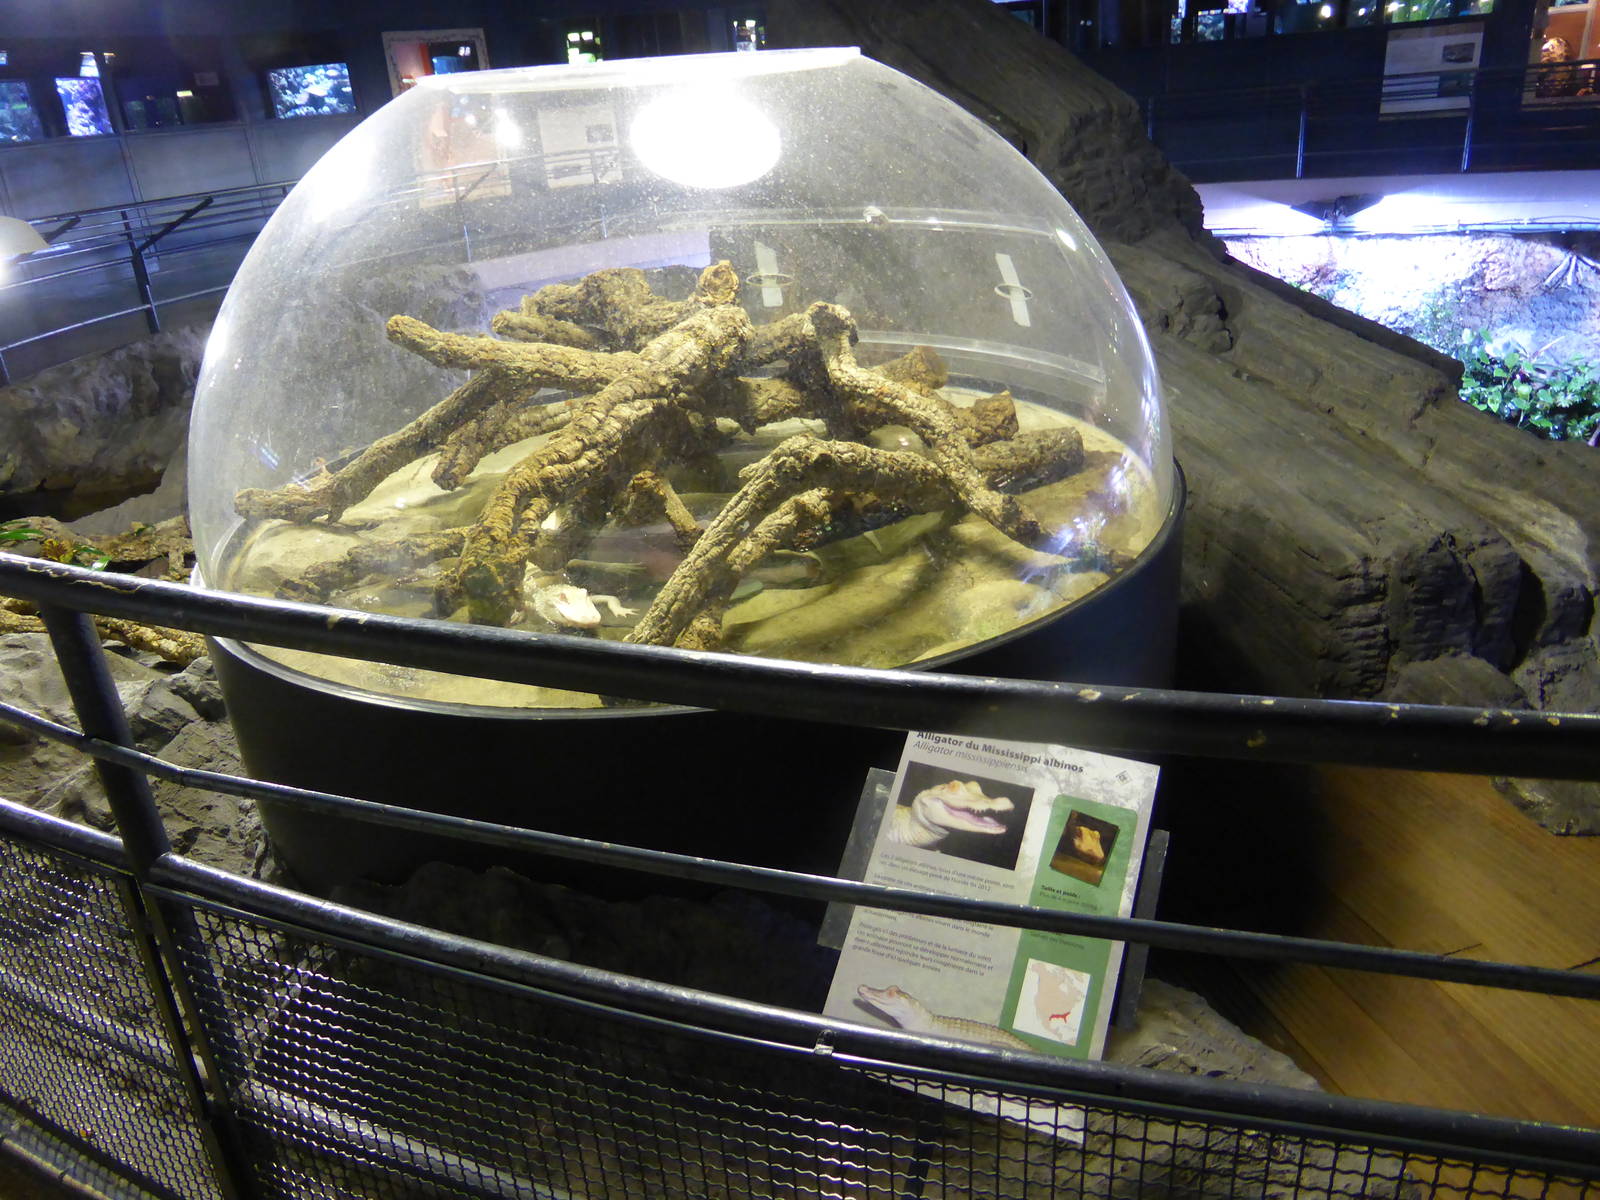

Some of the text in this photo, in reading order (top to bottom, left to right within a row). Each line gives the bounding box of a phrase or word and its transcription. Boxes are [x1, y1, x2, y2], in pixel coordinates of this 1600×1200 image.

[913, 740, 954, 756] Alligator
[917, 731, 1084, 773] Alligator du Mississippi albinos
